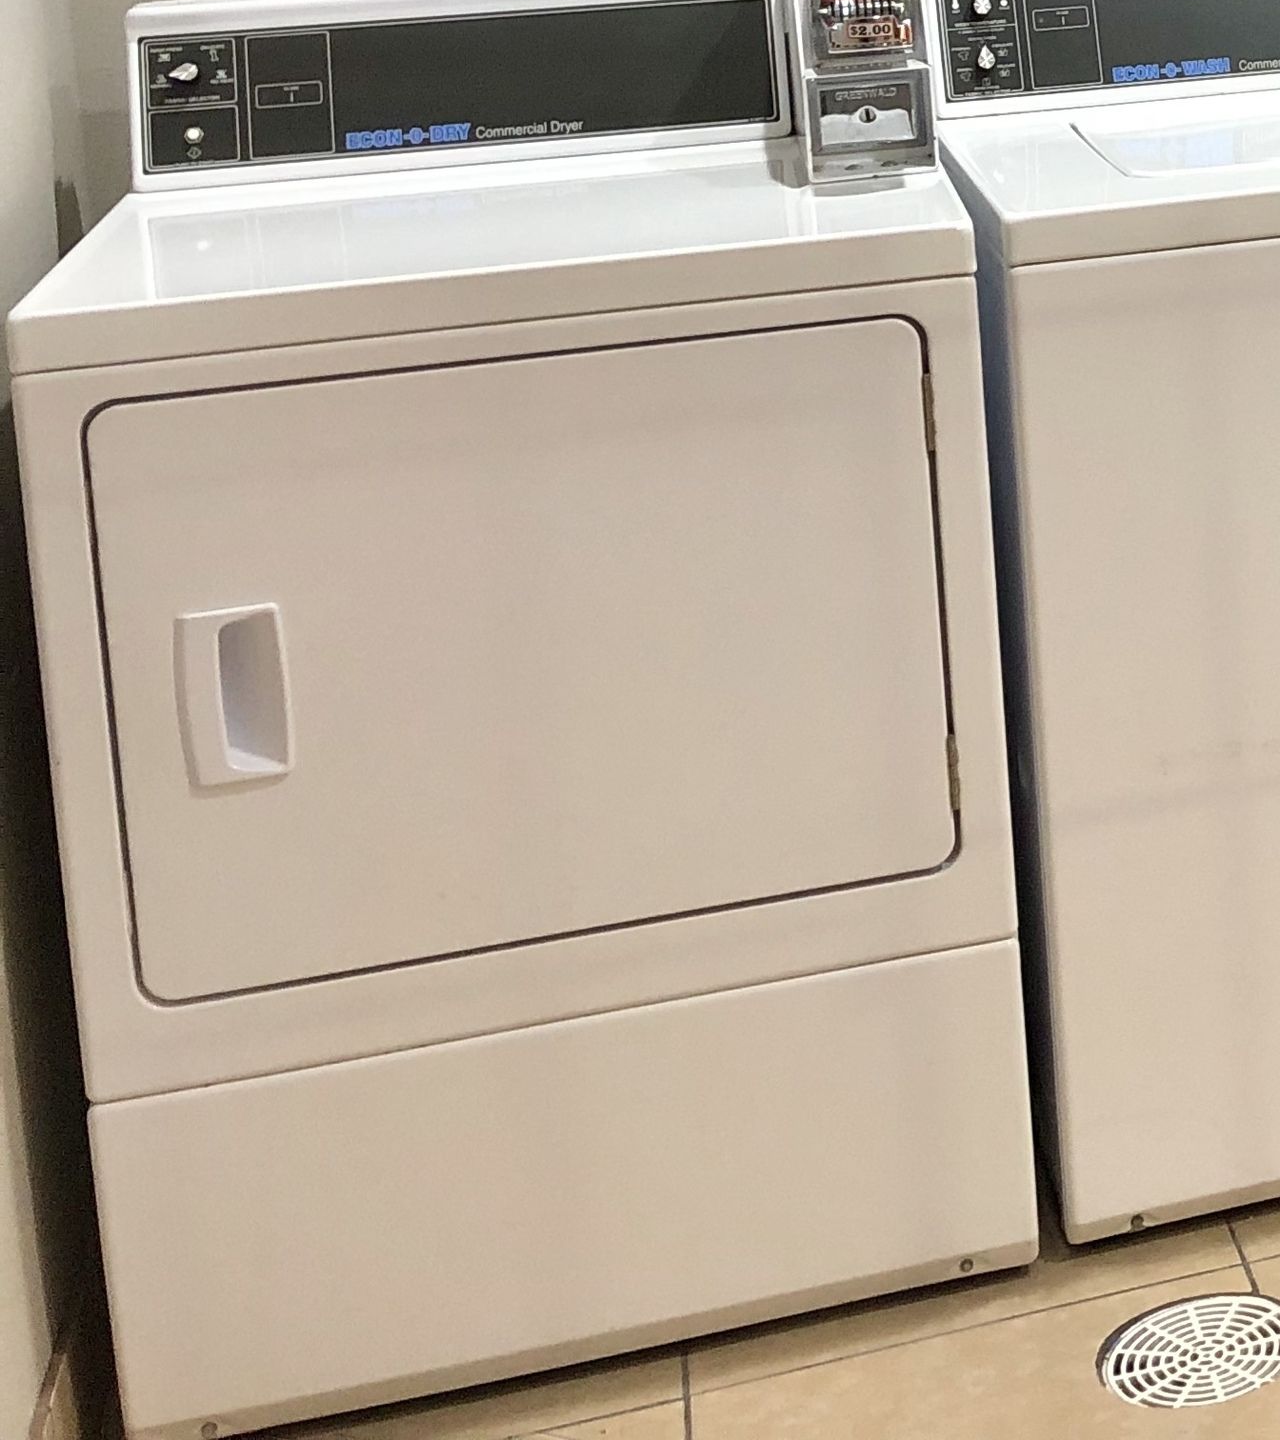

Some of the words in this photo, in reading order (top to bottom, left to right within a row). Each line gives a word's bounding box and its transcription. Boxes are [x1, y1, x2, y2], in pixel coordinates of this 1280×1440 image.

[849, 24, 892, 36] $2.00
[475, 121, 548, 139] Commercial
[550, 119, 584, 136] Dryer
